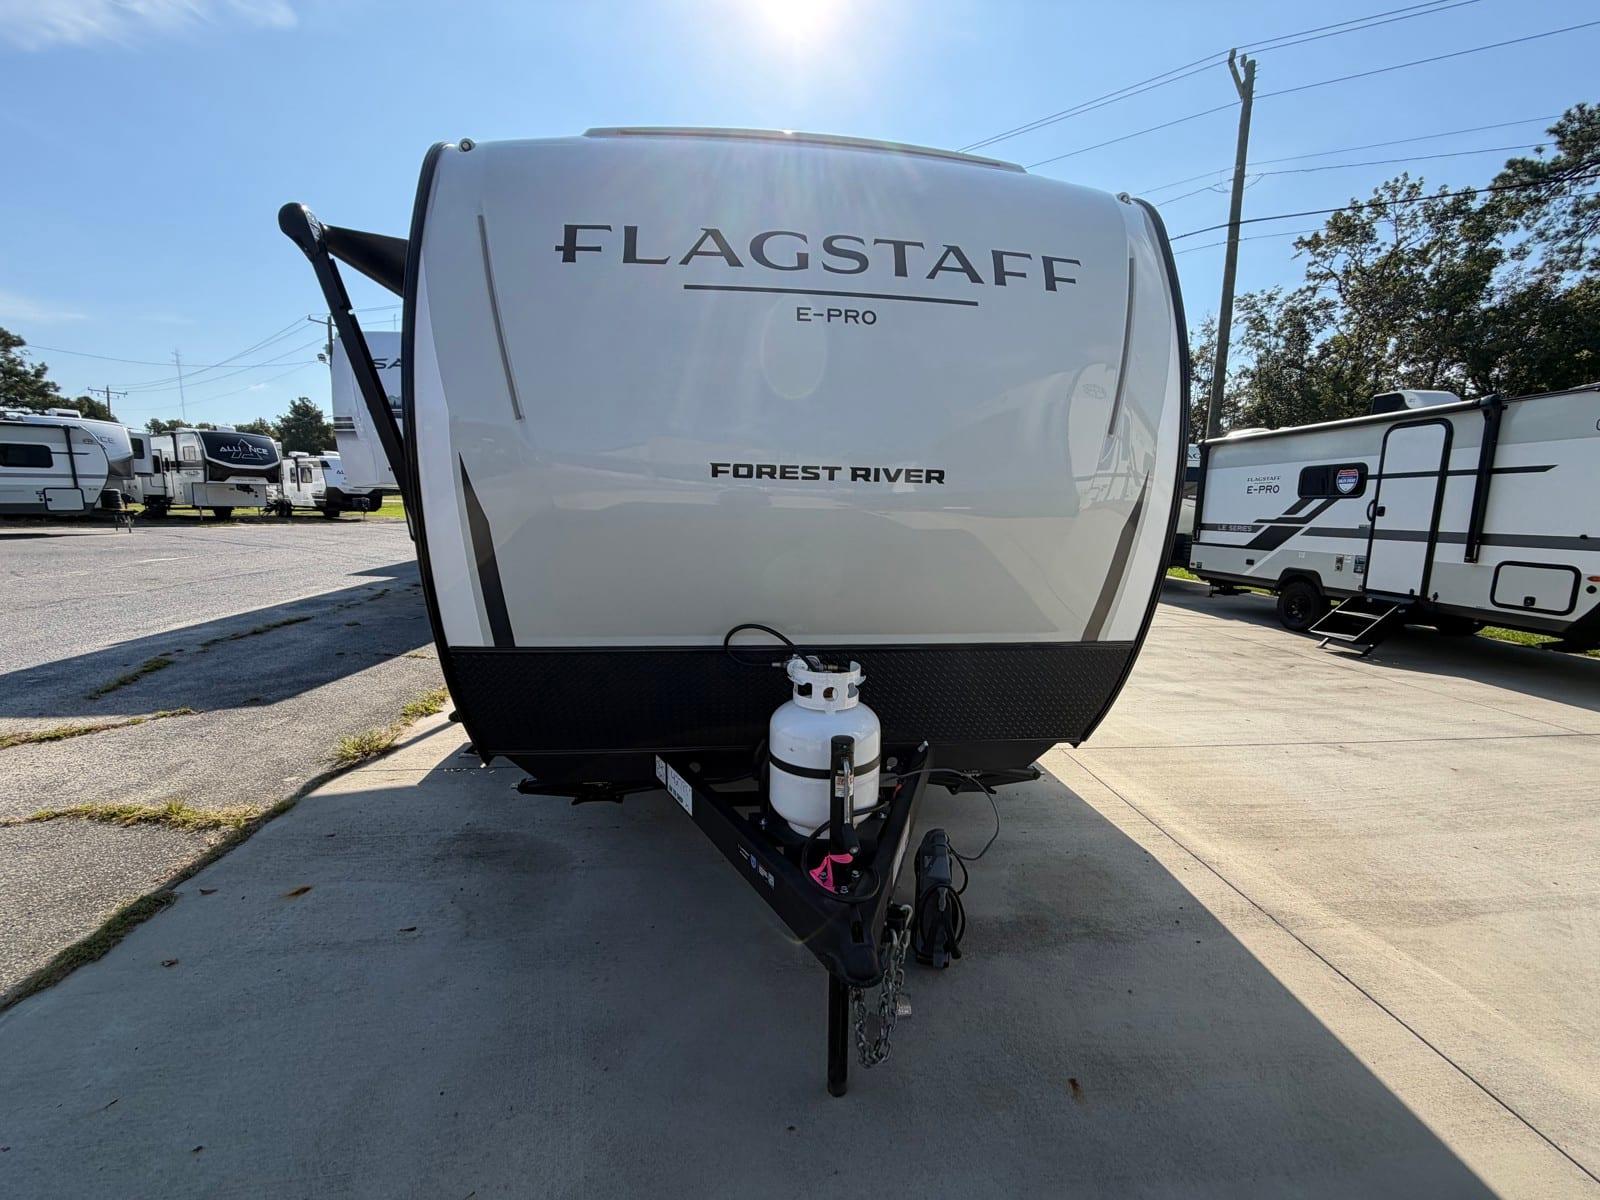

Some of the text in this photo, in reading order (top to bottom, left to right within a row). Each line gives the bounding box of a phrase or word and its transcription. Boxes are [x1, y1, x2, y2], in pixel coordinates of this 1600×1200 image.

[555, 224, 1082, 292] FLAGSTAFF
[796, 306, 878, 326] E-PRO
[709, 462, 945, 484] FOREST RIVER
[1246, 484, 1280, 494] E-PRO
